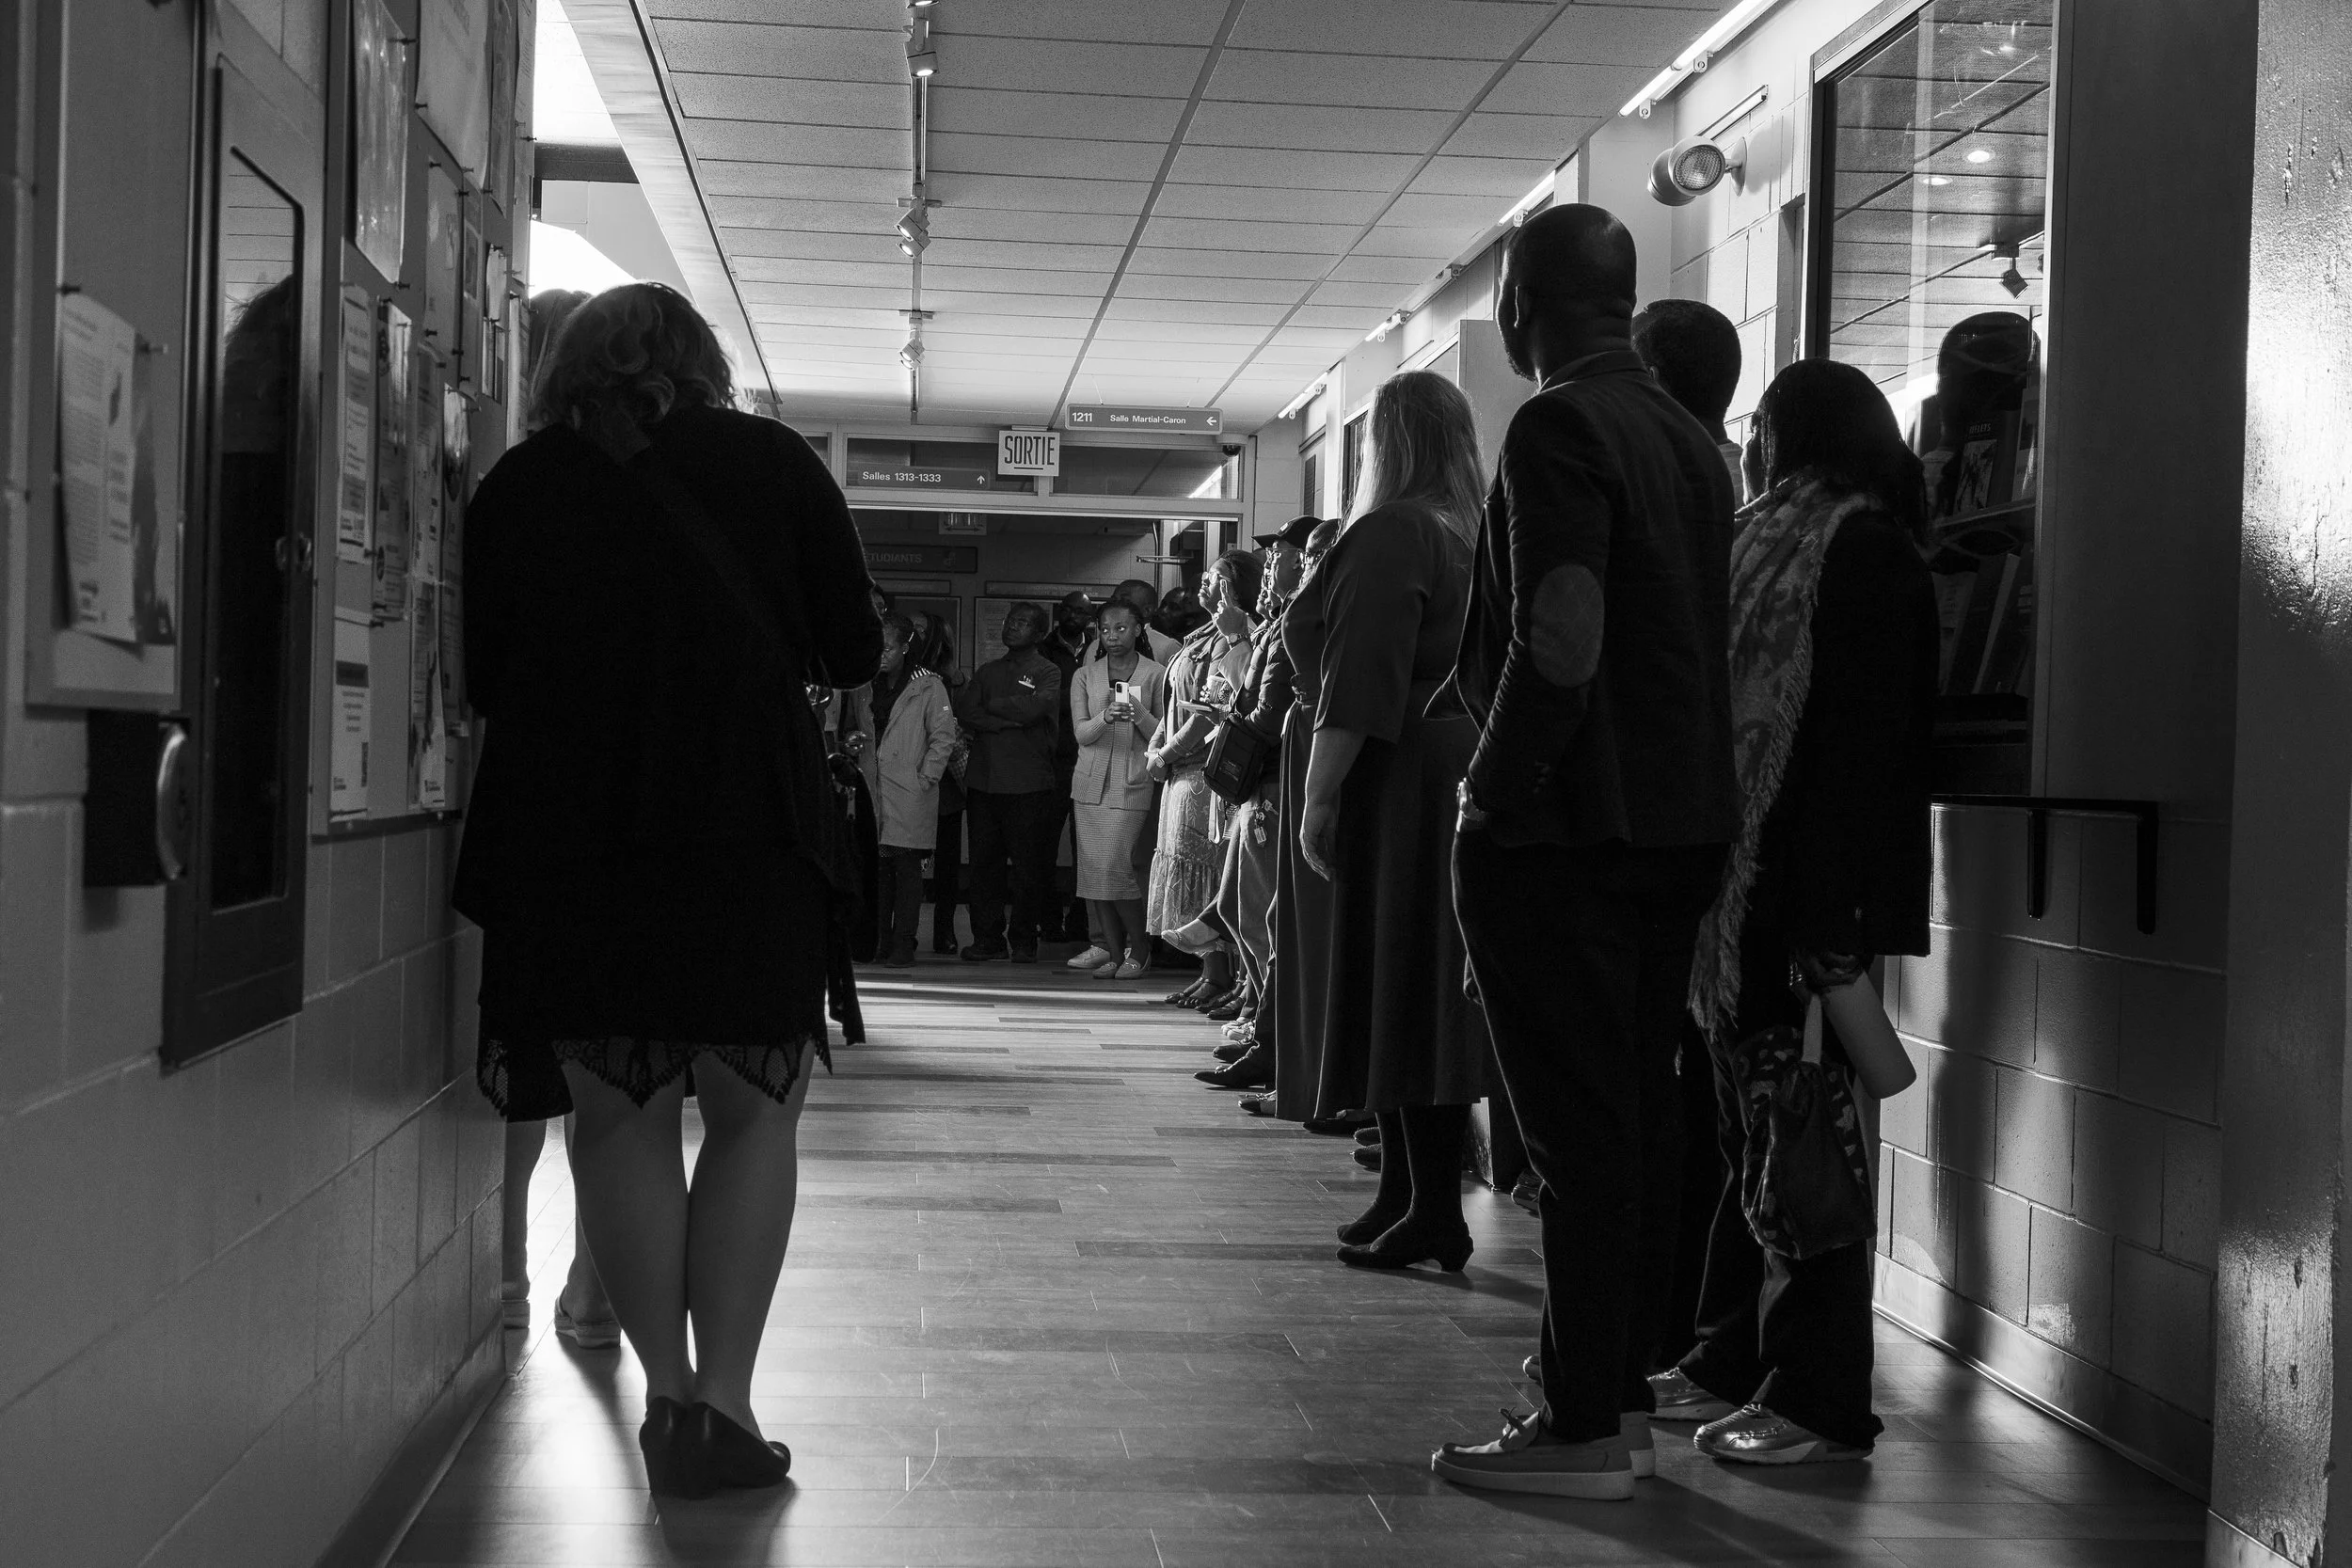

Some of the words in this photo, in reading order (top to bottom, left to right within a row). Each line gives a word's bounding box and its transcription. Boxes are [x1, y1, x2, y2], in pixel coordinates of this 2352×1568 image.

[1072, 412, 1092, 422] 1211
[1110, 414, 1129, 422] Salle
[1132, 415, 1186, 424] Martial-Caron
[1004, 436, 1056, 466] SORTIE
[862, 471, 891, 481] Salles
[894, 472, 942, 483] 1313-1333
